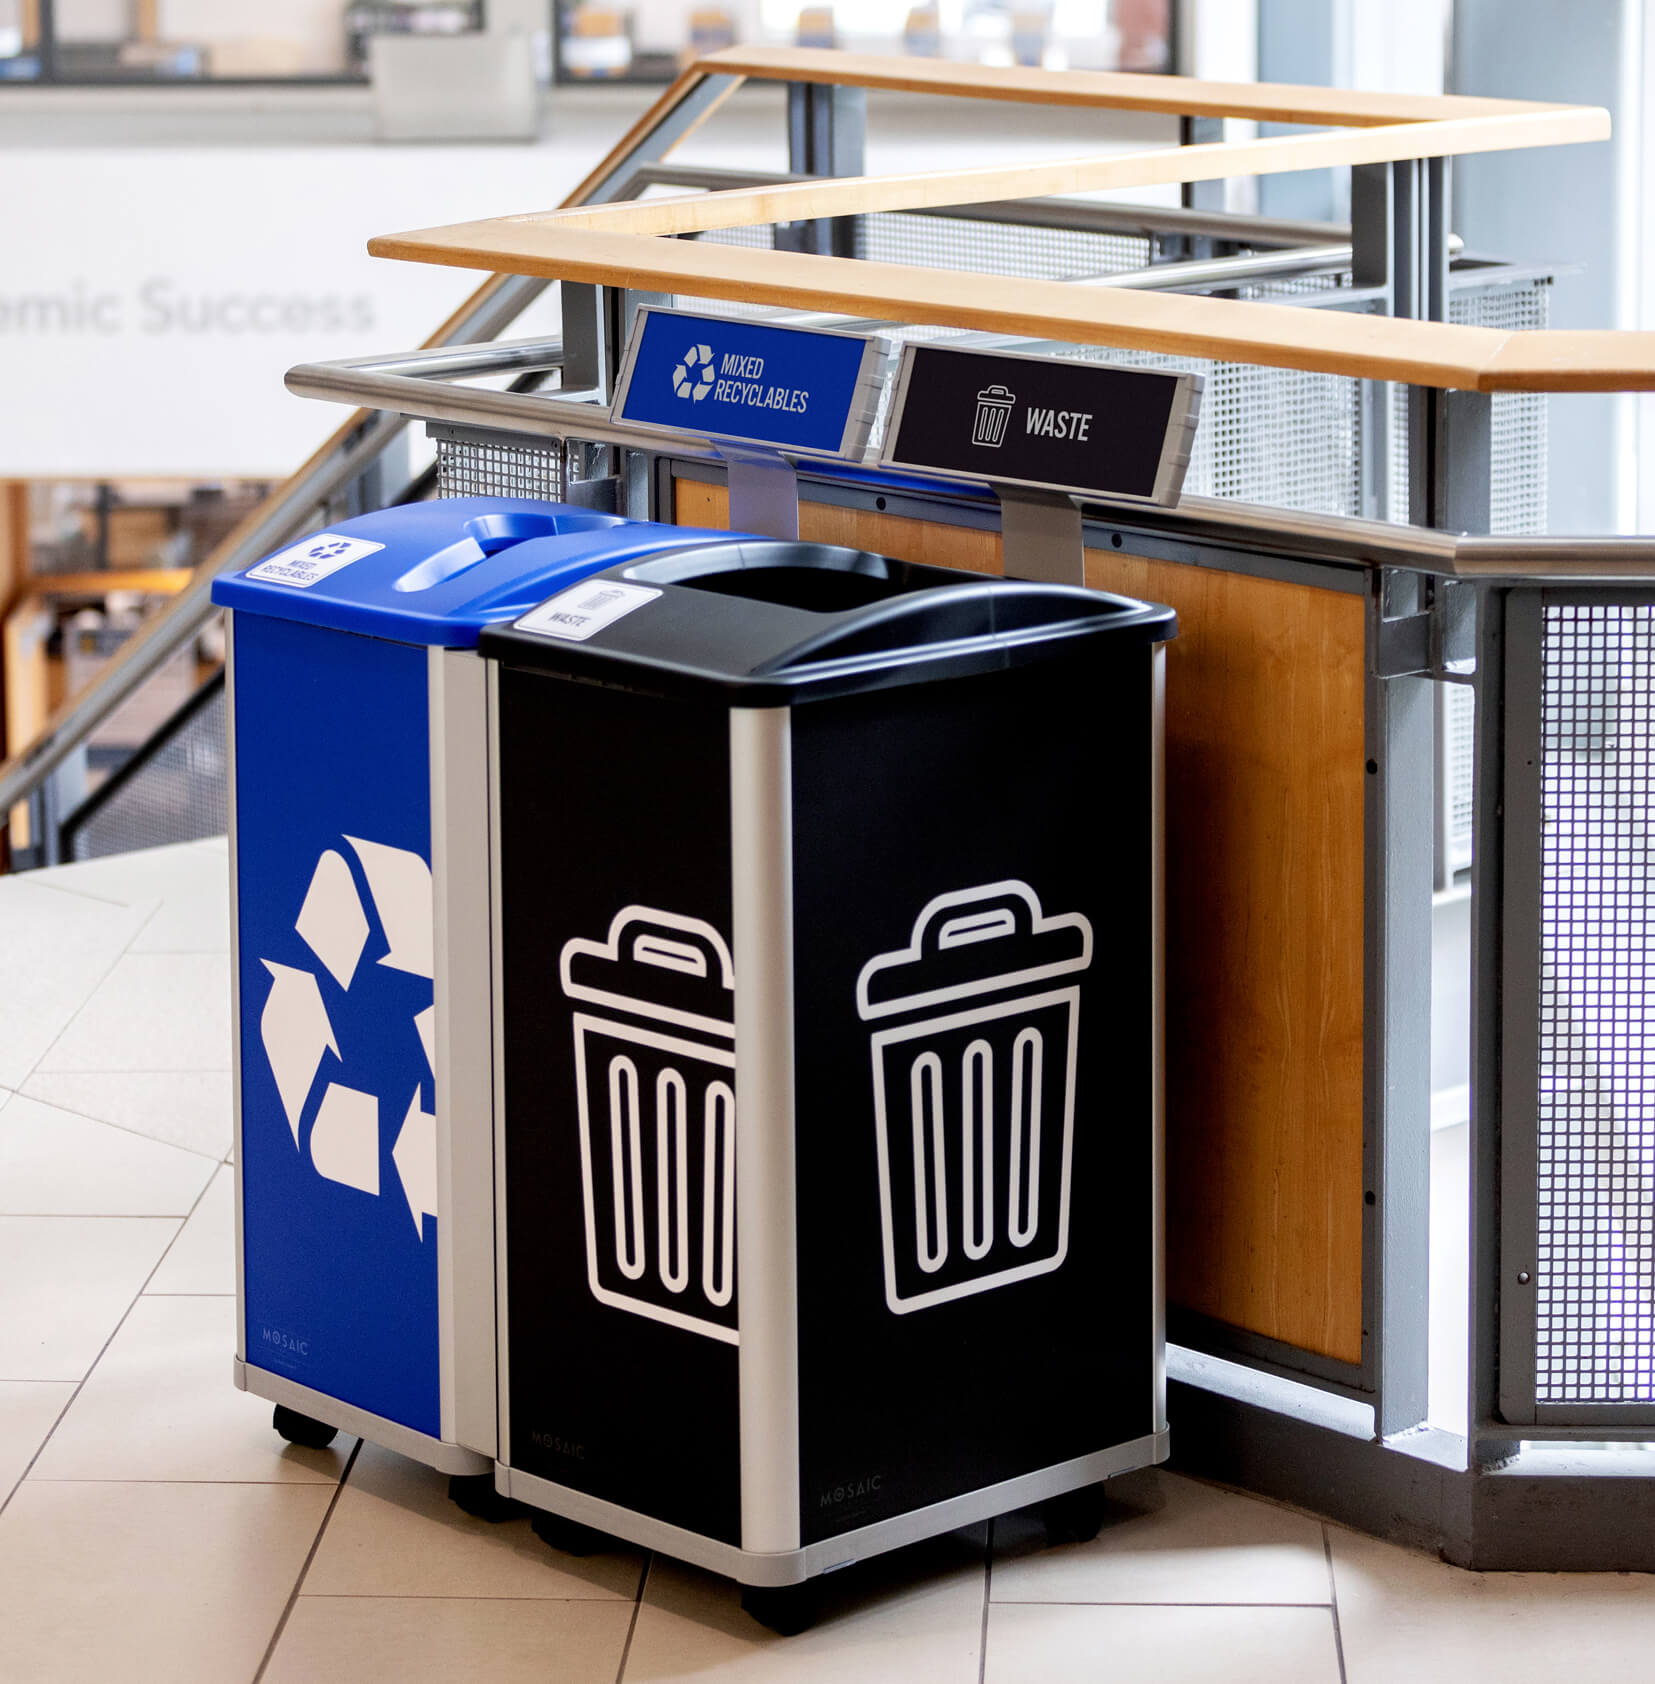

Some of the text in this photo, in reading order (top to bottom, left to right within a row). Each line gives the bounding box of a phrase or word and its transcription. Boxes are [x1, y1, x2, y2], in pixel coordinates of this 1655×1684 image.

[137, 274, 377, 336] Success
[720, 353, 765, 379] MIXED
[714, 379, 809, 414] RECYCLABLES
[1026, 407, 1093, 442] WASTE
[261, 564, 319, 581] RECYCLABLES
[548, 612, 591, 626] WASTE
[262, 1327, 309, 1356] MOSAIC
[529, 1430, 585, 1460] MOSAIC
[819, 1475, 881, 1508] MOSAIC
